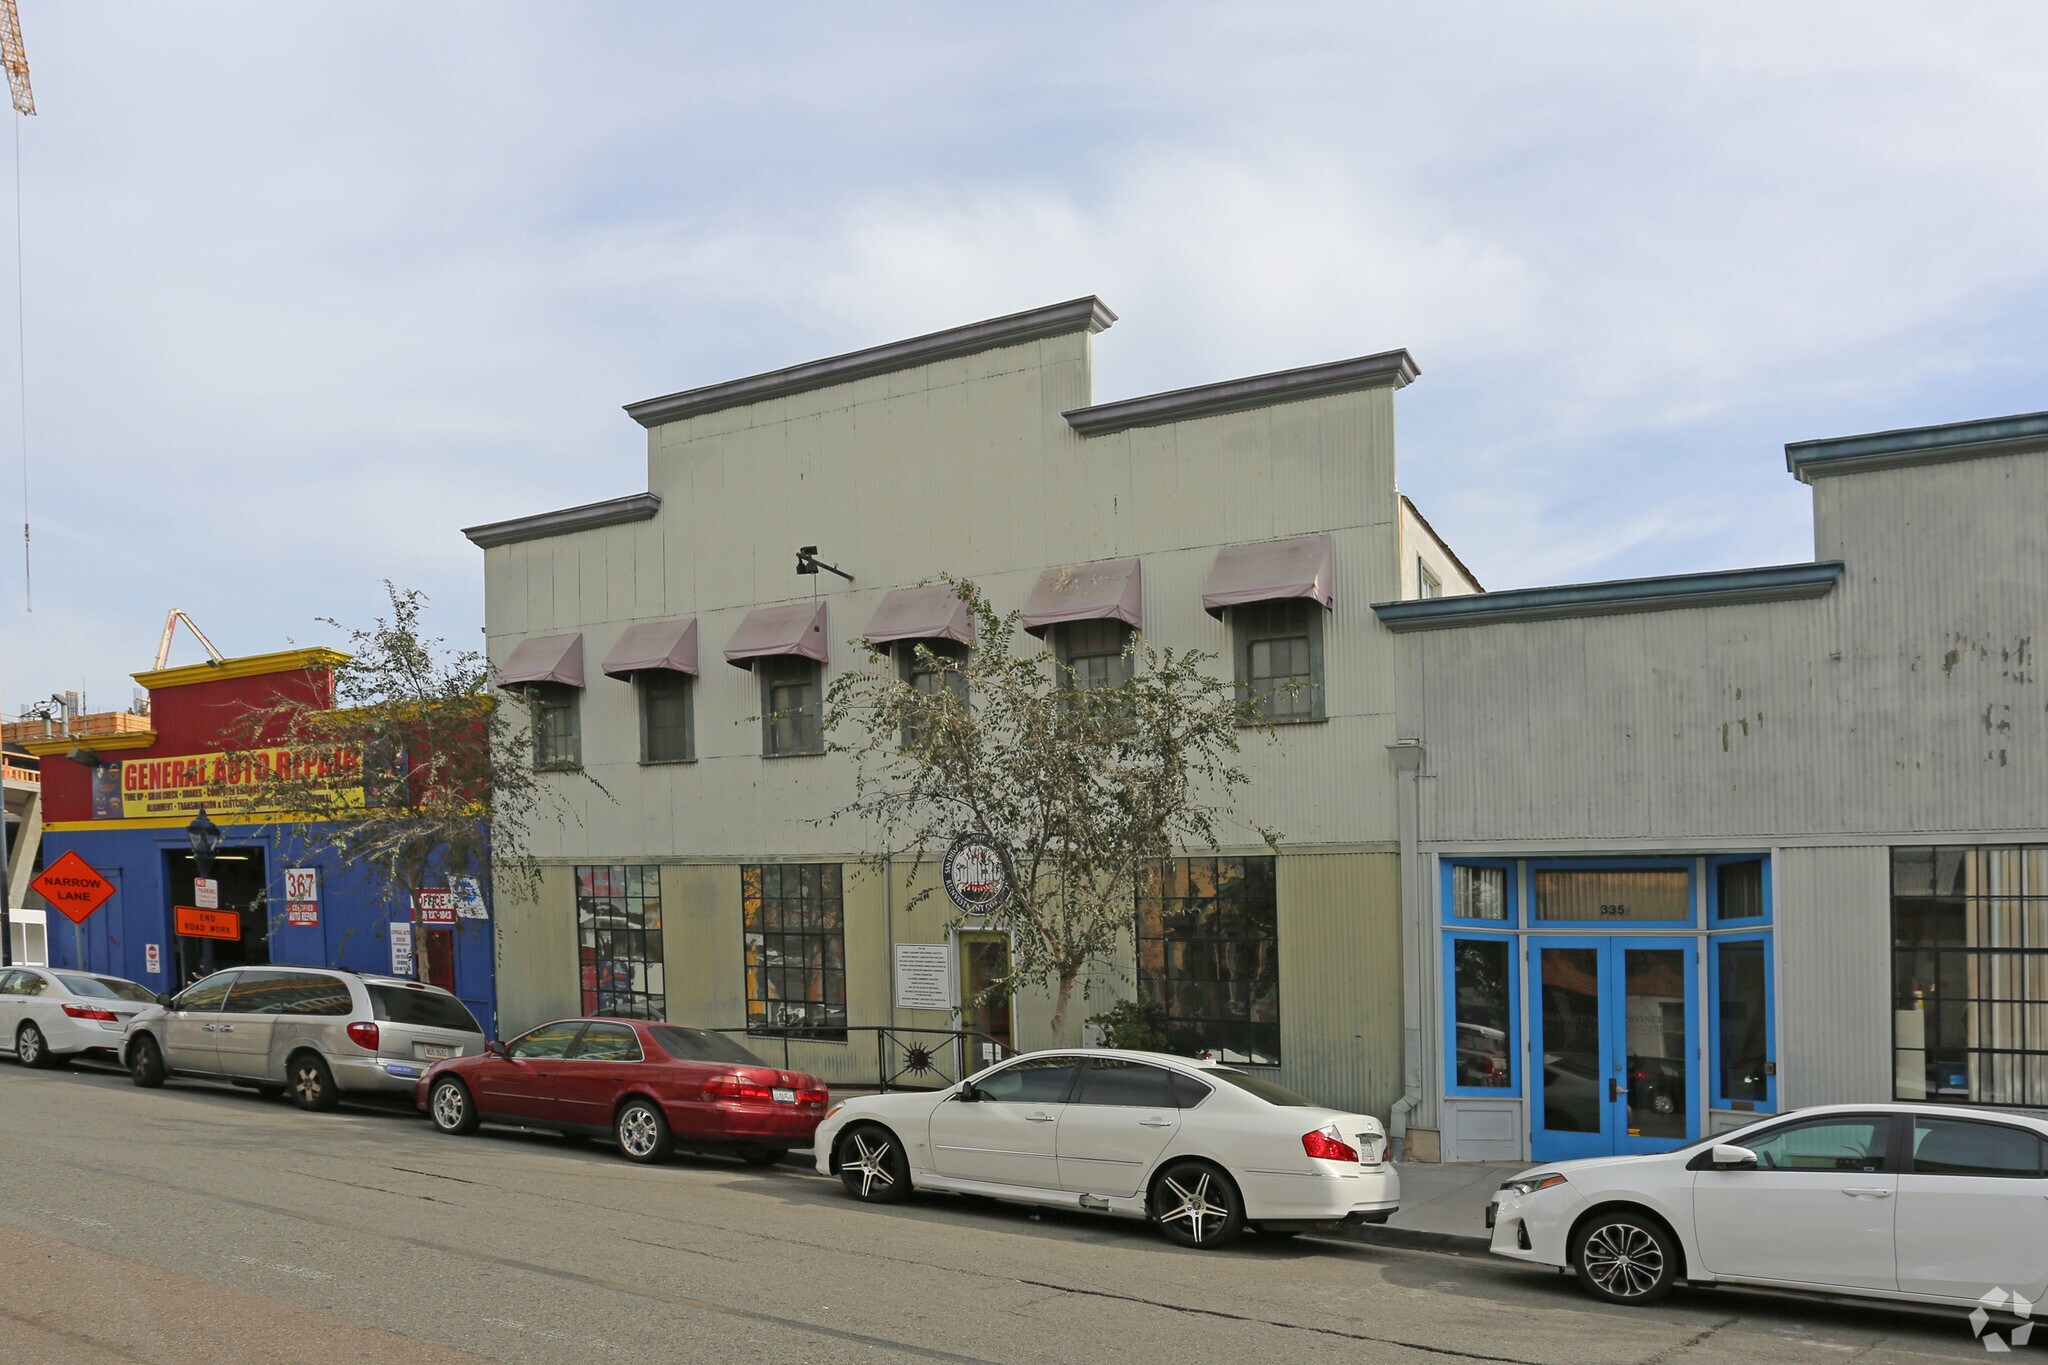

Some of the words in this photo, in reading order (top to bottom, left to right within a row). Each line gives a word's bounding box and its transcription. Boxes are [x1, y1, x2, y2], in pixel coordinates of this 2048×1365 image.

[124, 758, 207, 791] GENERAL
[213, 752, 270, 785] AUTO
[44, 877, 101, 888] NARROW
[288, 874, 314, 897] 367
[57, 892, 90, 901] LANE
[1600, 904, 1625, 915] 335
[200, 913, 216, 923] END
[301, 911, 318, 922] REPAIR
[184, 922, 206, 931] ROAD
[209, 925, 232, 934] WORK
